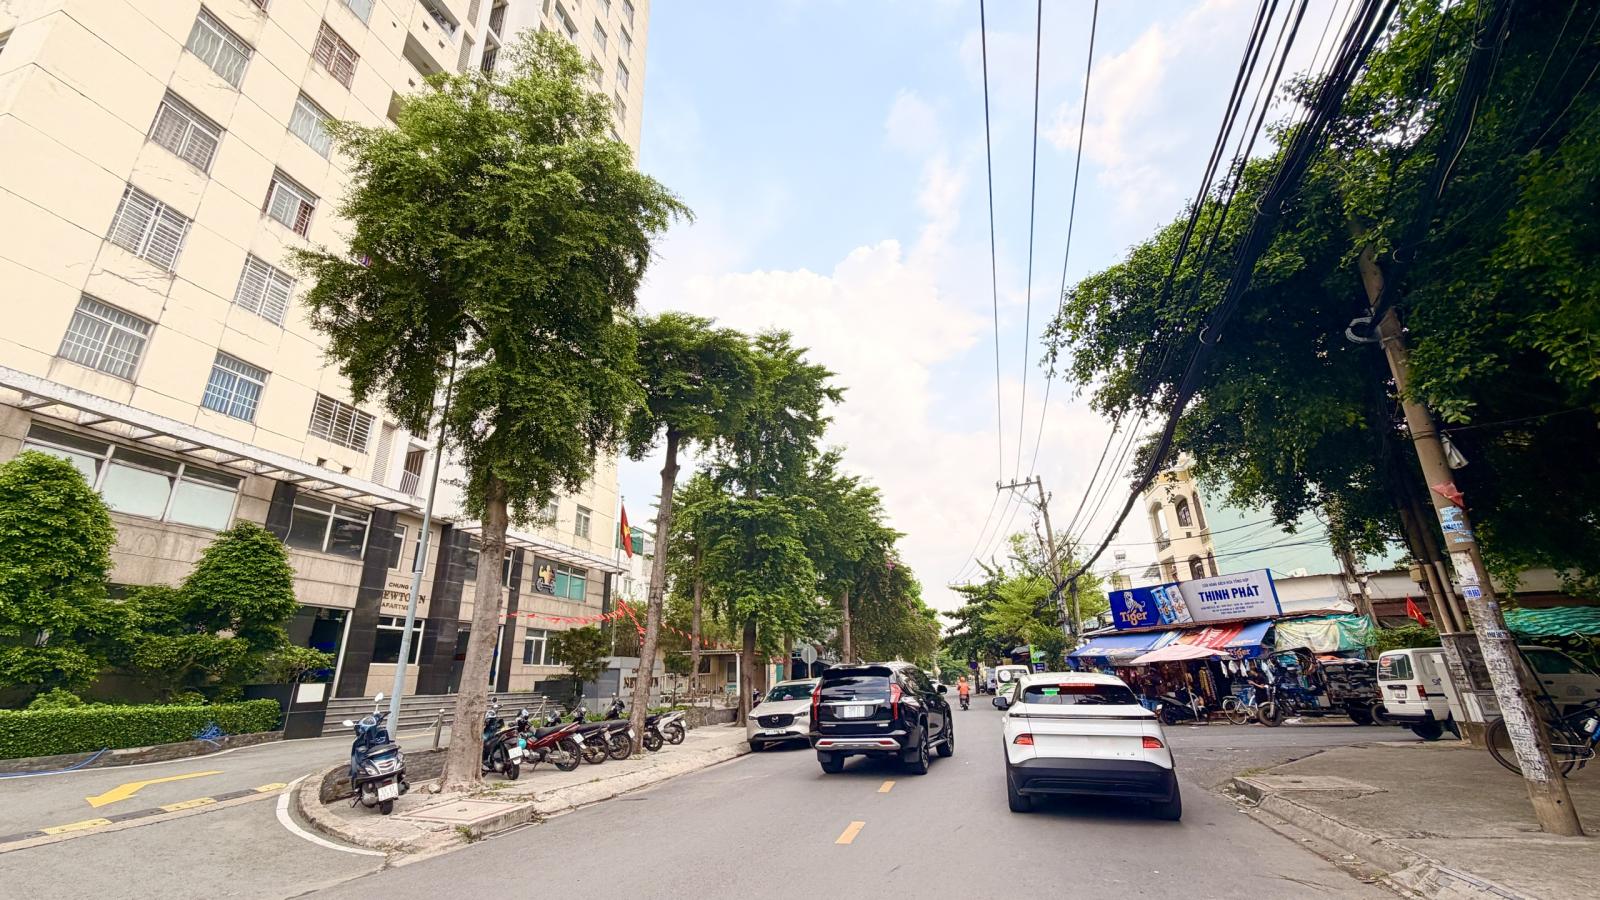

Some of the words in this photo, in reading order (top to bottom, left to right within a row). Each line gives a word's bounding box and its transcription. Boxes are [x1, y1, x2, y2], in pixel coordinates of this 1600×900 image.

[388, 582, 409, 590] CHUNG
[1198, 588, 1230, 604] THỊNH
[1231, 583, 1259, 598] PHÁT
[1119, 608, 1148, 626] Tiger
